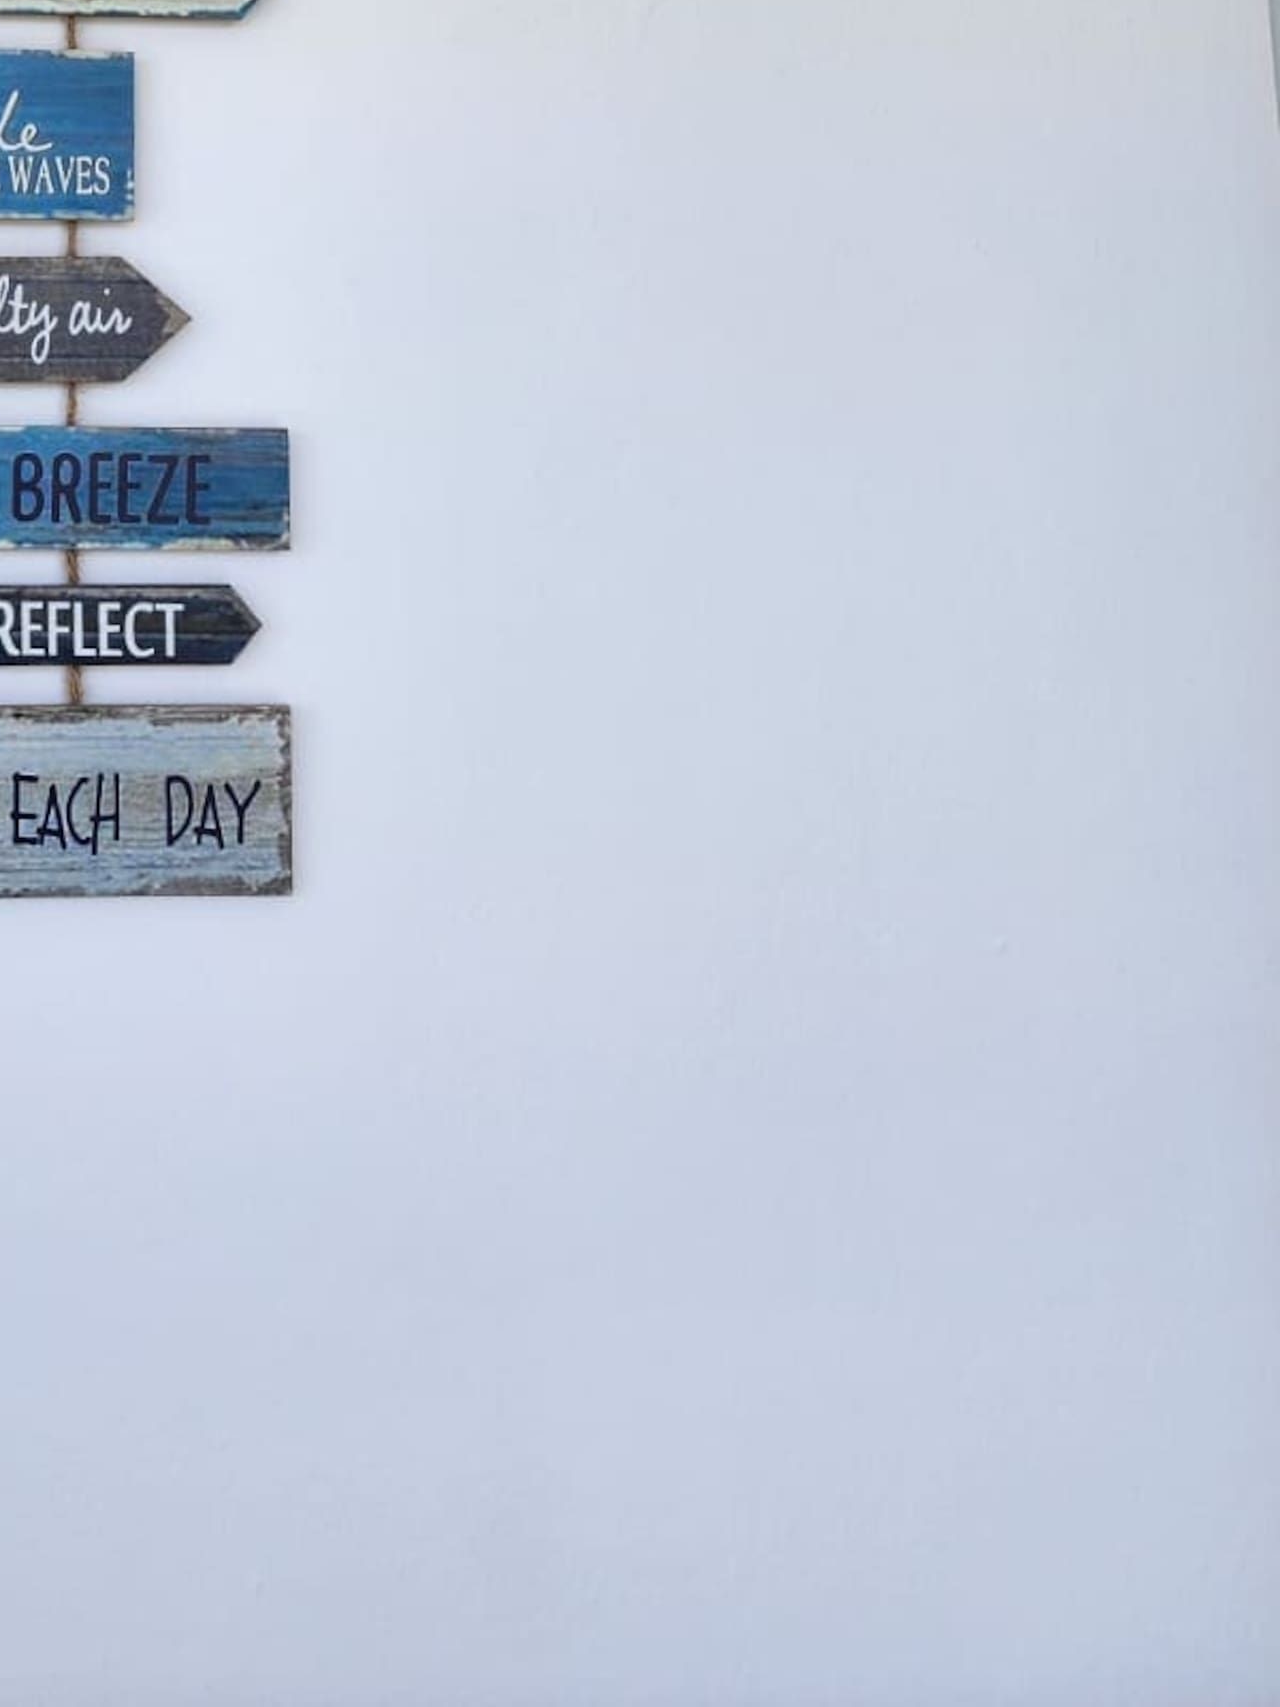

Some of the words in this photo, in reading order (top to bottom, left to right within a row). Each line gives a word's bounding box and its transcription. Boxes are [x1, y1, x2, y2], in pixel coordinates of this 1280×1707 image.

[8, 157, 111, 195] WAVES
[67, 288, 133, 333] air
[10, 453, 211, 525] BREEZE
[10, 772, 122, 855] EACH
[165, 775, 262, 849] DAY
